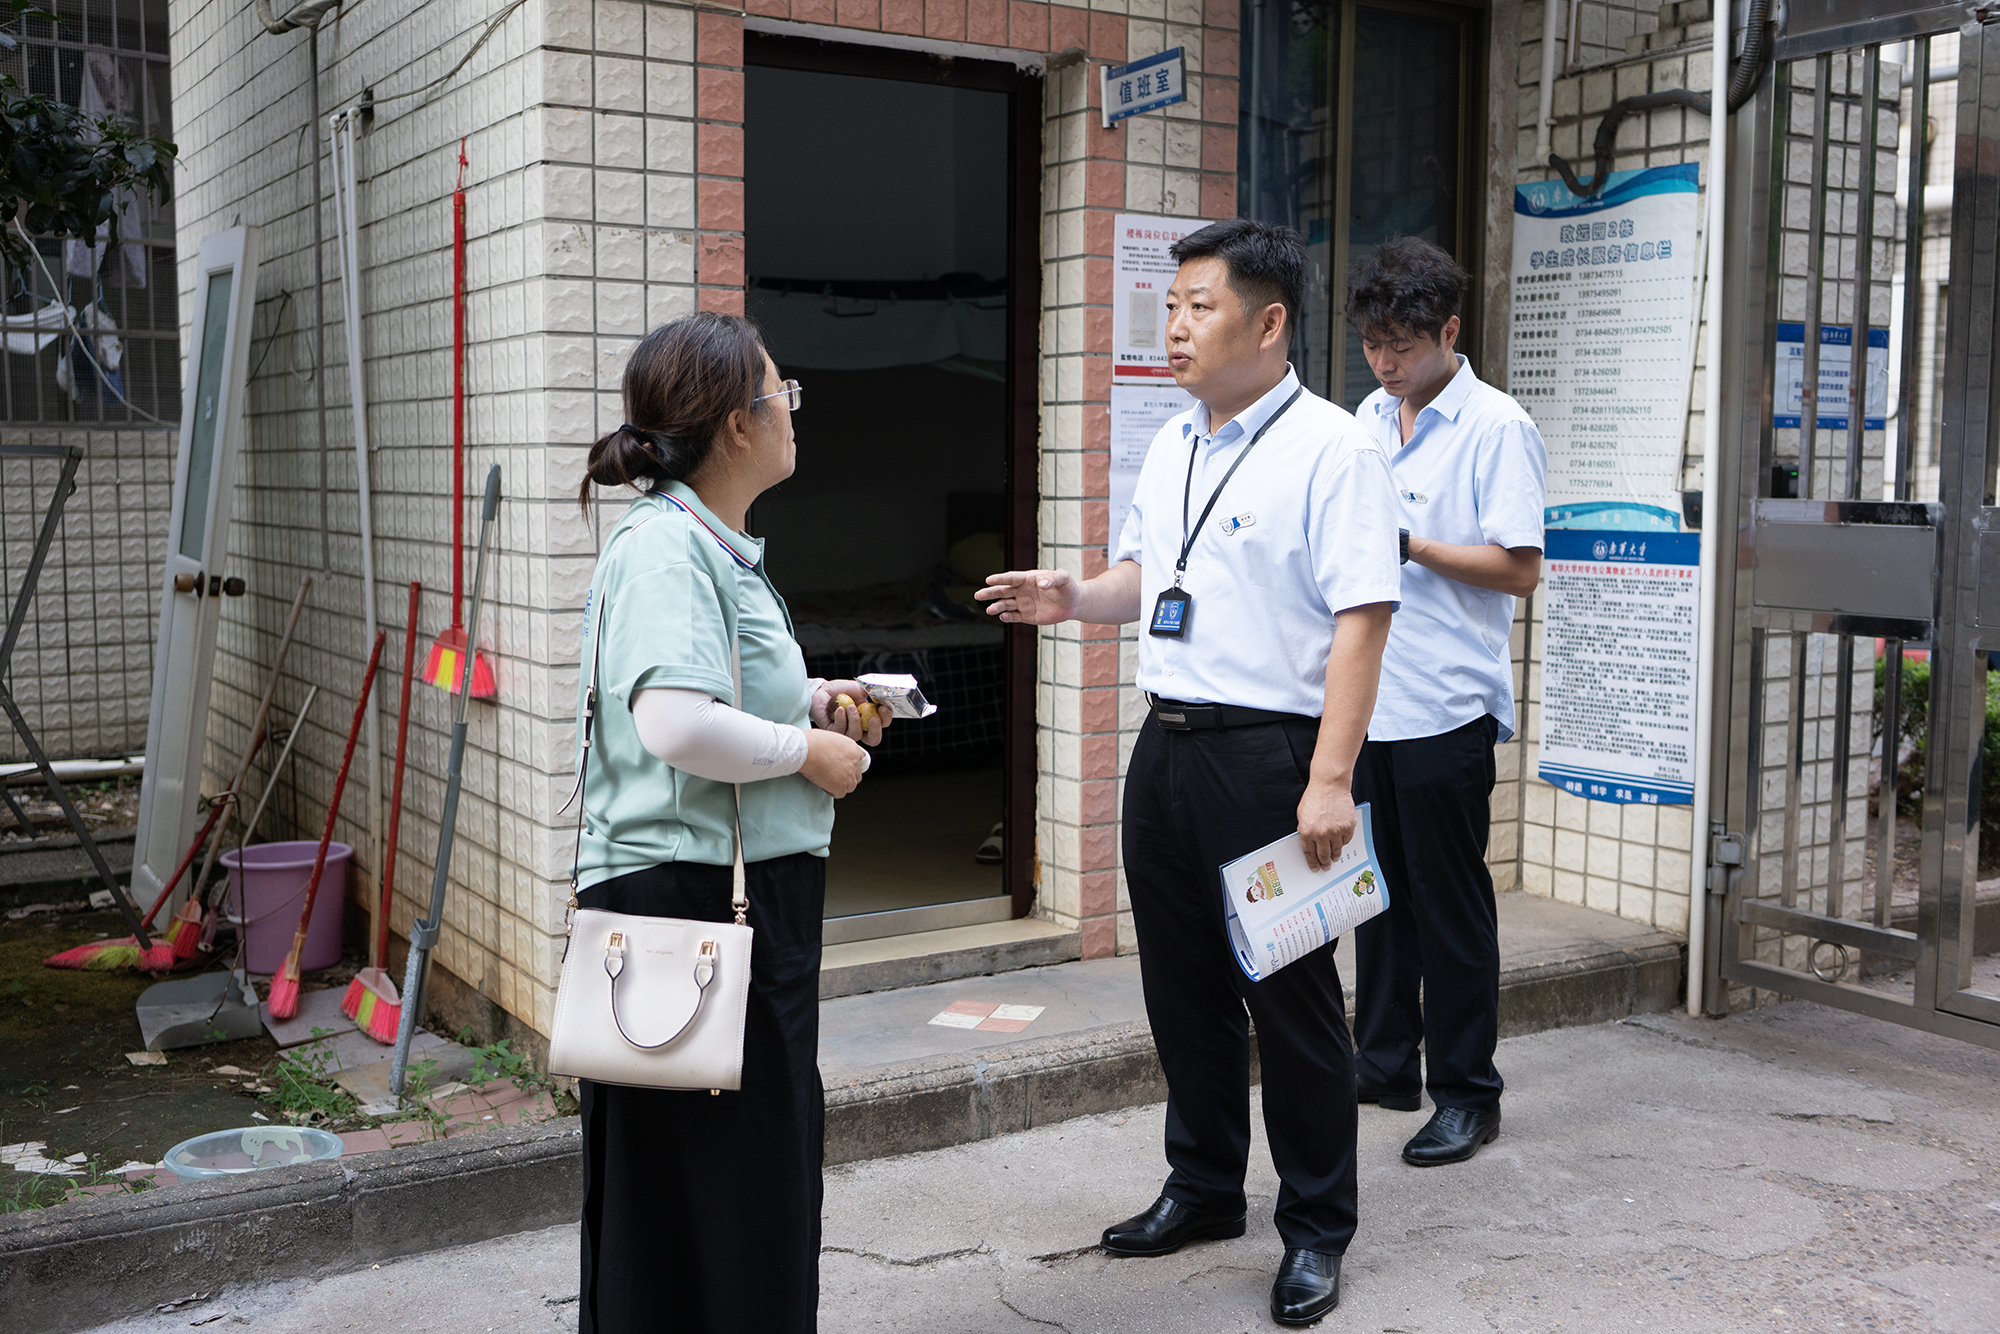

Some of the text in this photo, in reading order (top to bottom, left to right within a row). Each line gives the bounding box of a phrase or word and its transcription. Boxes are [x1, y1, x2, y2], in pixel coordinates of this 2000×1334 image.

[1118, 68, 1170, 105] 值班室
[1560, 219, 1635, 244] 致远园2栋
[1530, 240, 1673, 270] 学生成长服务信息栏
[1515, 292, 1560, 303] 热水服务电话
[1513, 329, 1558, 340] 空调维修电话
[1609, 541, 1647, 557] 南华大学
[1550, 563, 1693, 580] 南华大学对学生公寓物业工作人员的若干要求
[1565, 780, 1659, 804] 明德 博学 求是 致远
